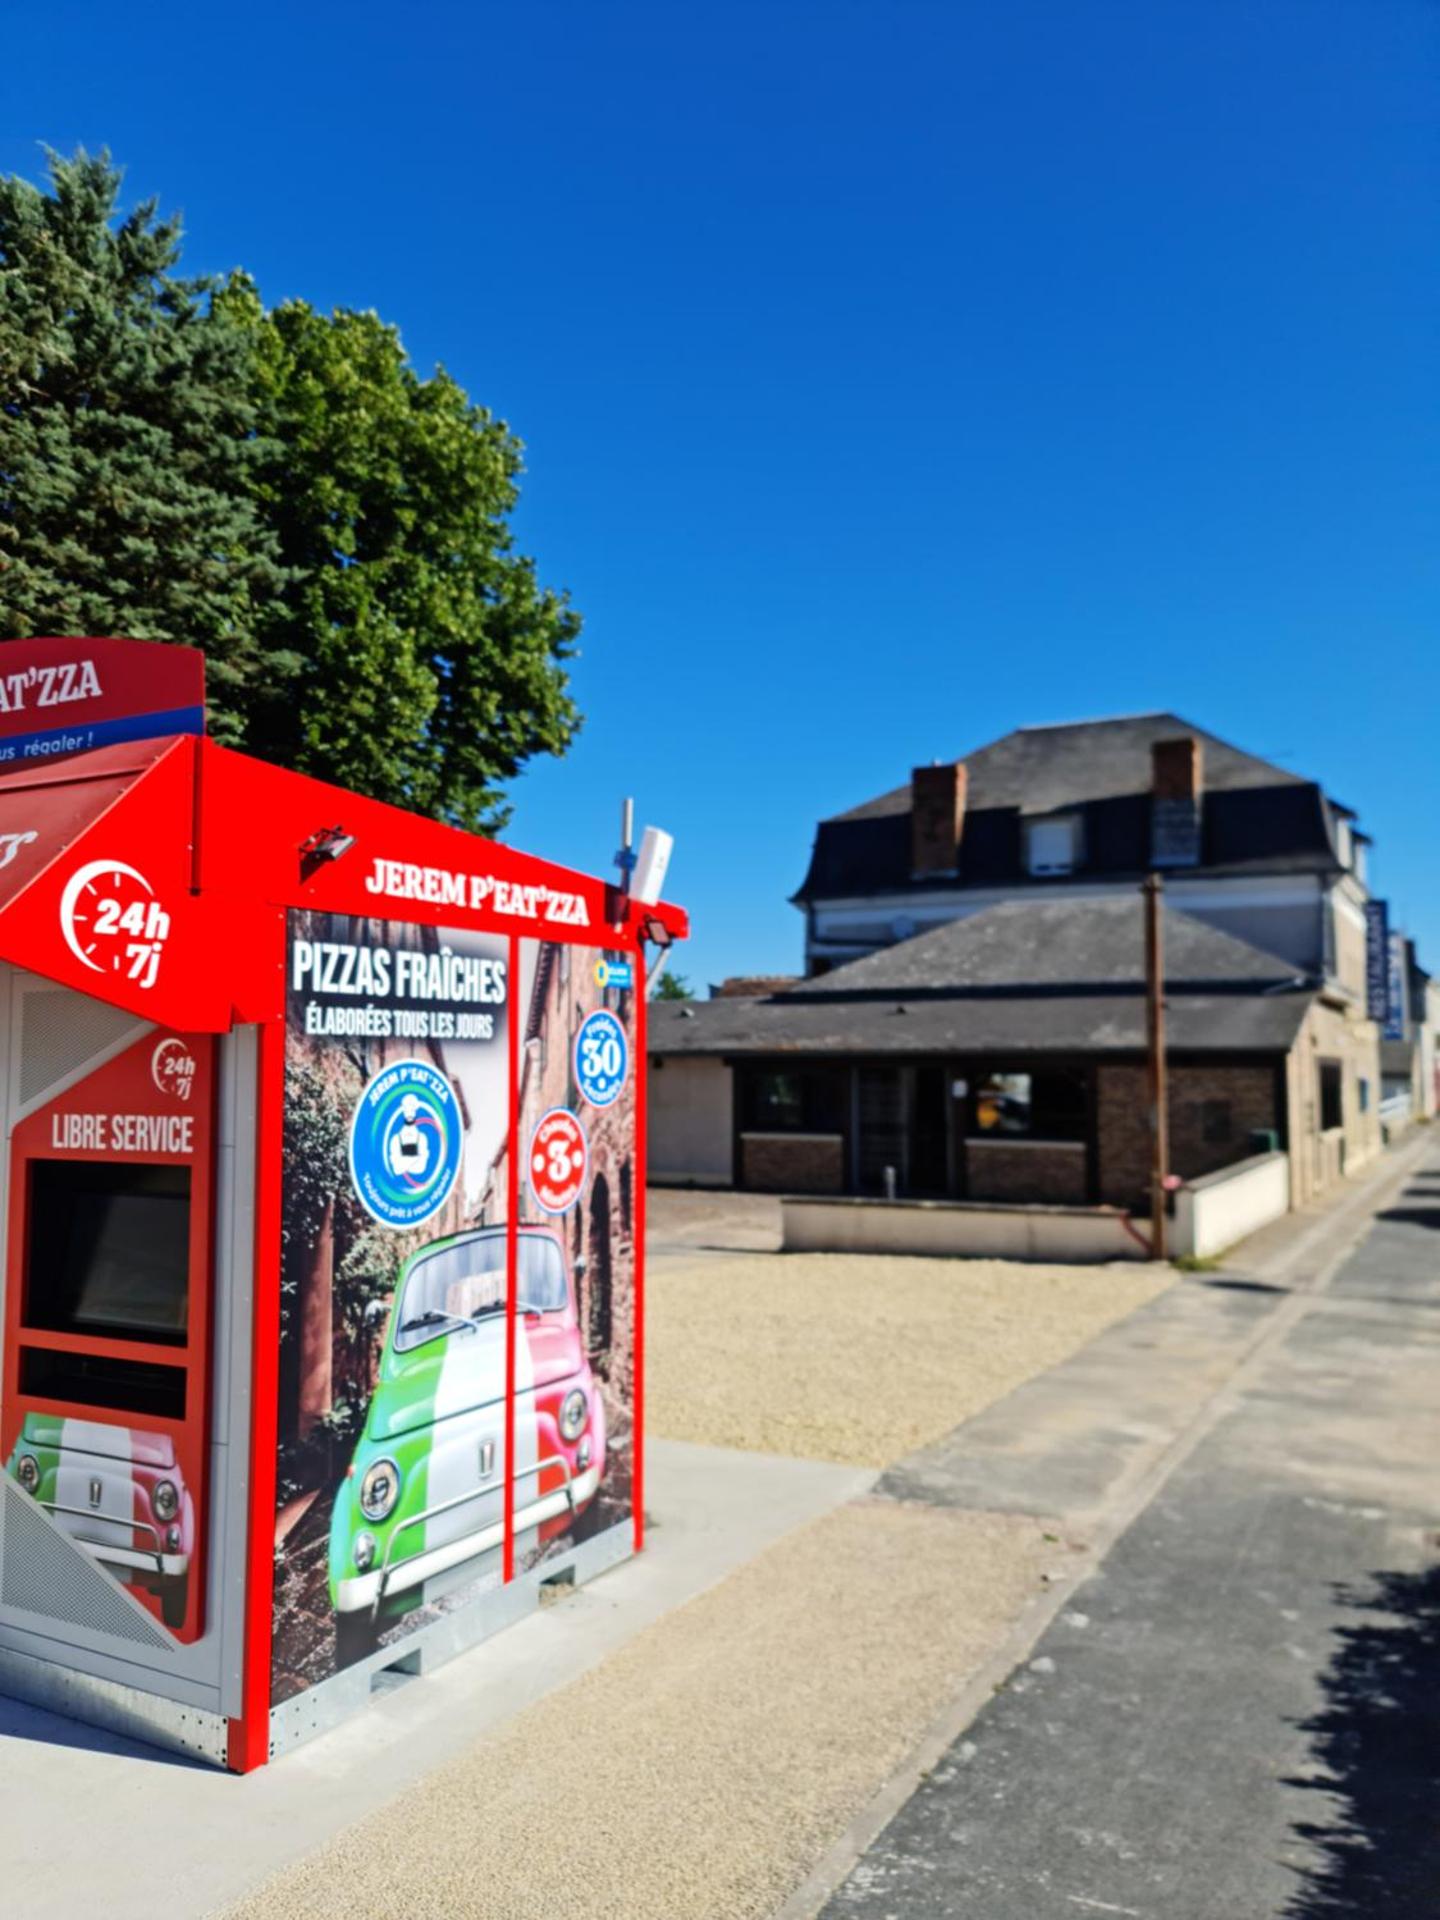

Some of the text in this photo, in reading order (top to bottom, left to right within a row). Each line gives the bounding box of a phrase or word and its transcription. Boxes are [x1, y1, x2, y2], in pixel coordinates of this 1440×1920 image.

[366, 858, 590, 926] JEREM P'EAT'ZZA
[93, 898, 171, 940] 24h
[126, 942, 163, 988] 7j
[293, 940, 506, 1004] PIZZAS FRAÎCHES
[306, 1001, 494, 1039] ÉLABORÉES TOUS LES JOURS
[164, 1056, 196, 1076] 24h
[582, 1038, 621, 1077] 30
[176, 1077, 192, 1101] 7j
[369, 1071, 399, 1107] JEREM
[53, 1114, 194, 1153] LIBRE SERVICE
[547, 1140, 572, 1182] 3
